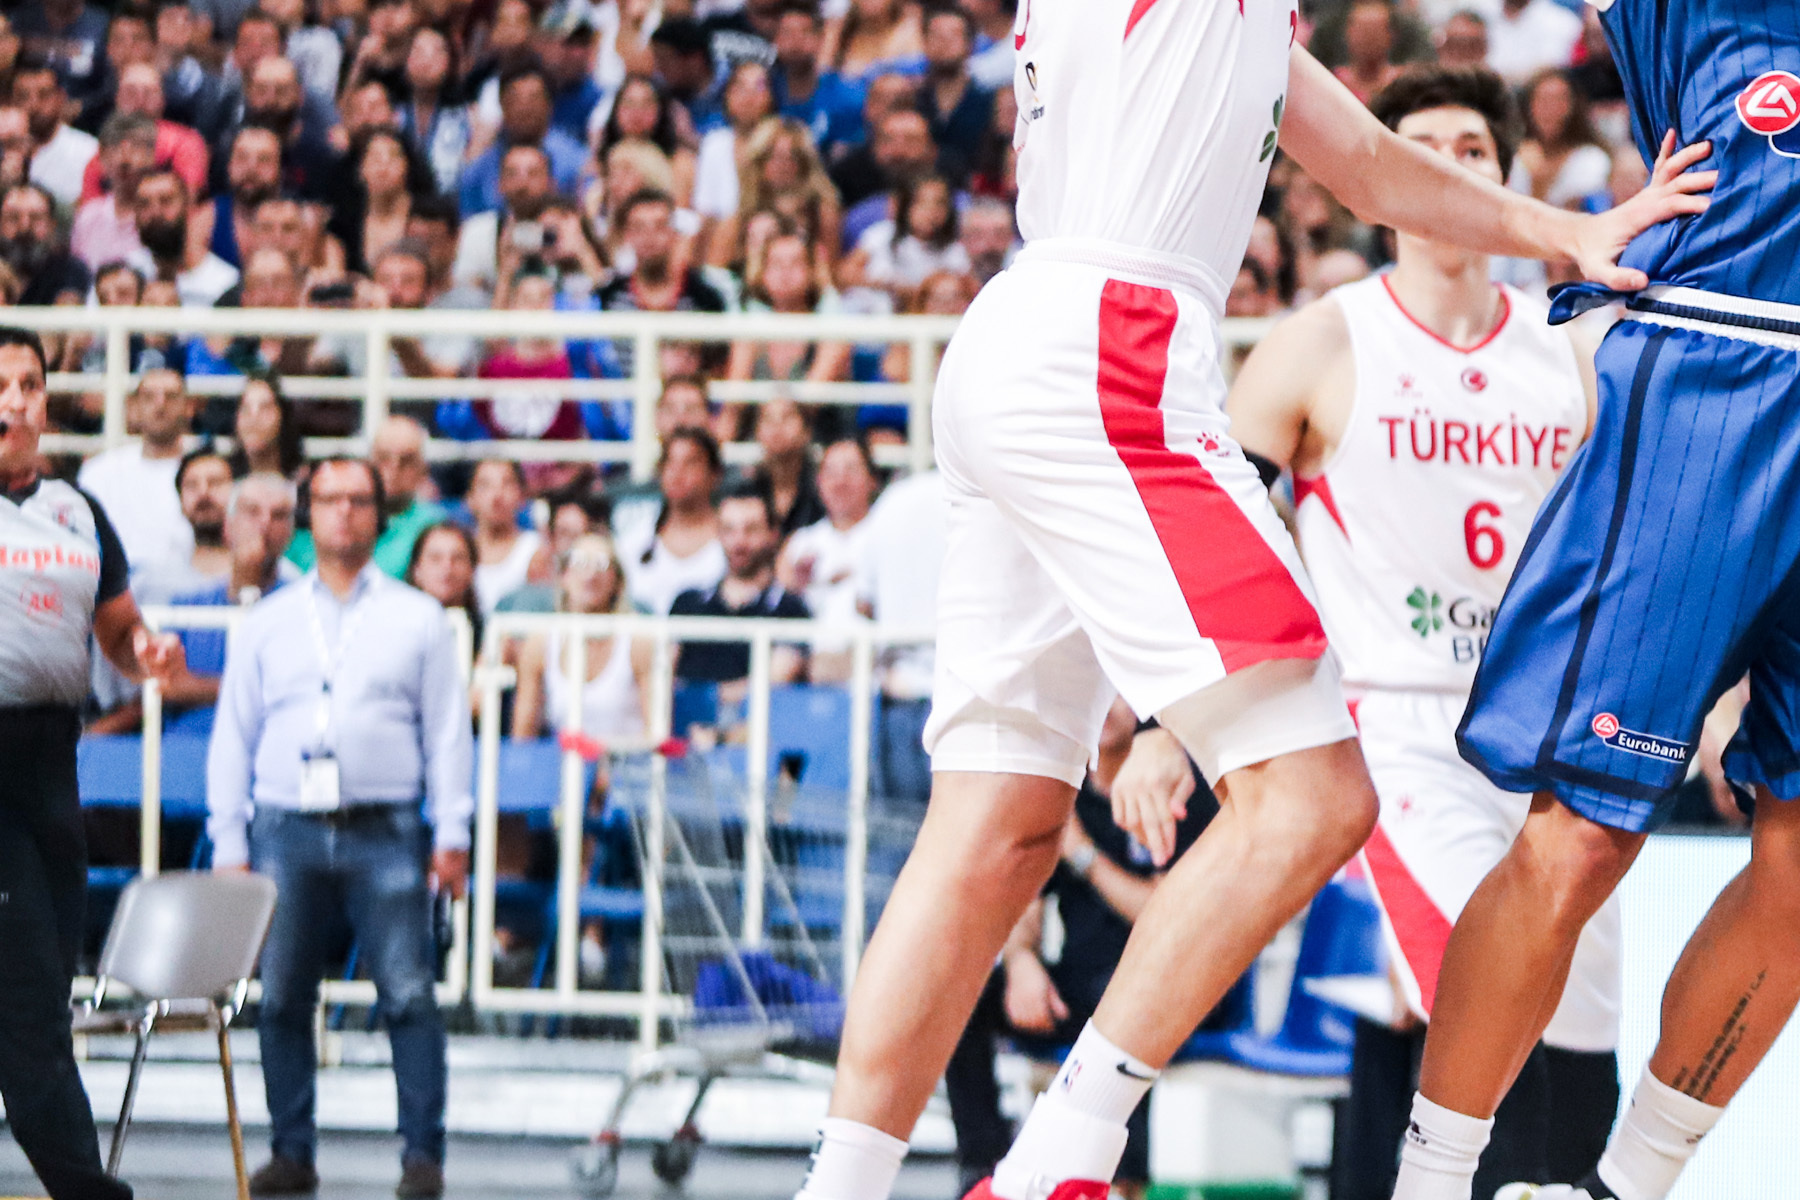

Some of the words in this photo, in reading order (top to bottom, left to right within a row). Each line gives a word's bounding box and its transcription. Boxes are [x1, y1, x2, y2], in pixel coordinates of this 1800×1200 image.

[1378, 407, 1572, 471] TÜRKİYE
[1463, 500, 1506, 570] 6
[1449, 596, 1497, 630] Ga
[1617, 731, 1687, 760] Eurobank
